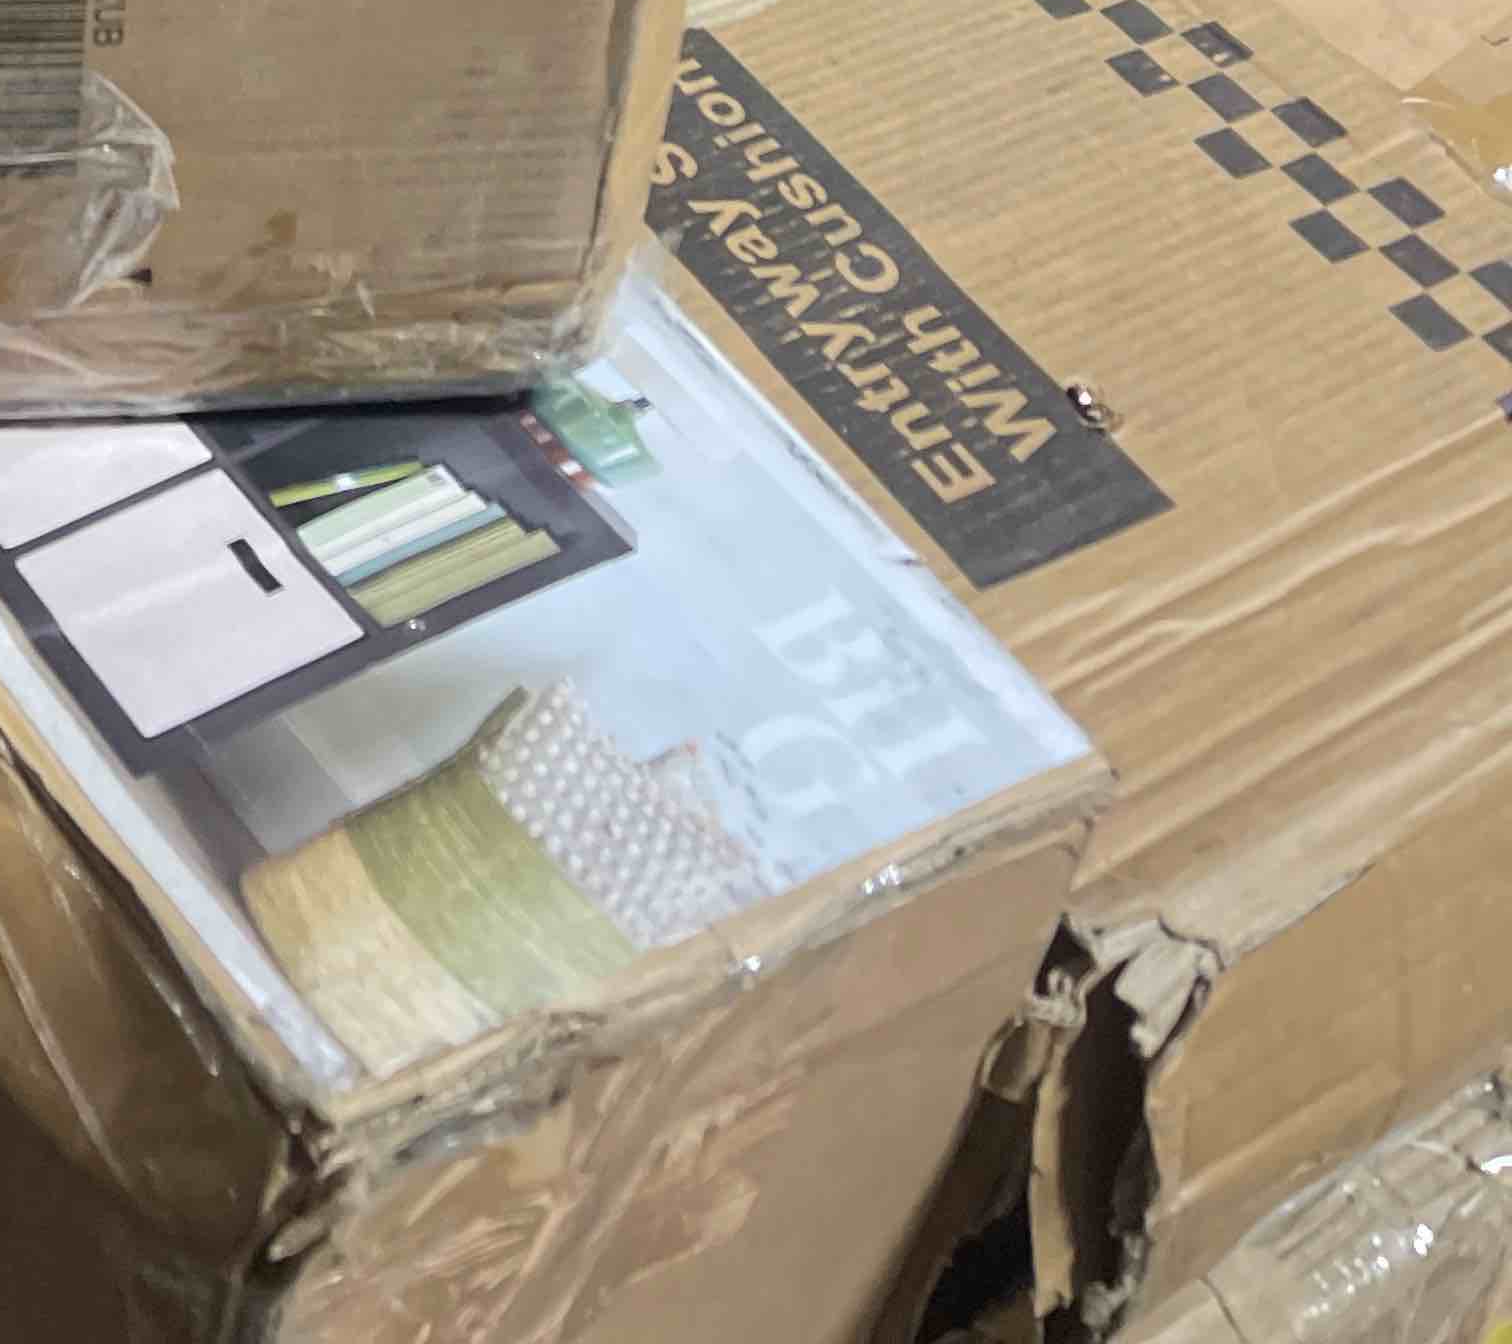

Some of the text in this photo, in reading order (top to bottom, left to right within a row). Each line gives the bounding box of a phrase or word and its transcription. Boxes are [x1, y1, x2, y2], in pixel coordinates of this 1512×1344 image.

[649, 141, 999, 506] Entryway S
[672, 56, 1058, 464] With Cushion
